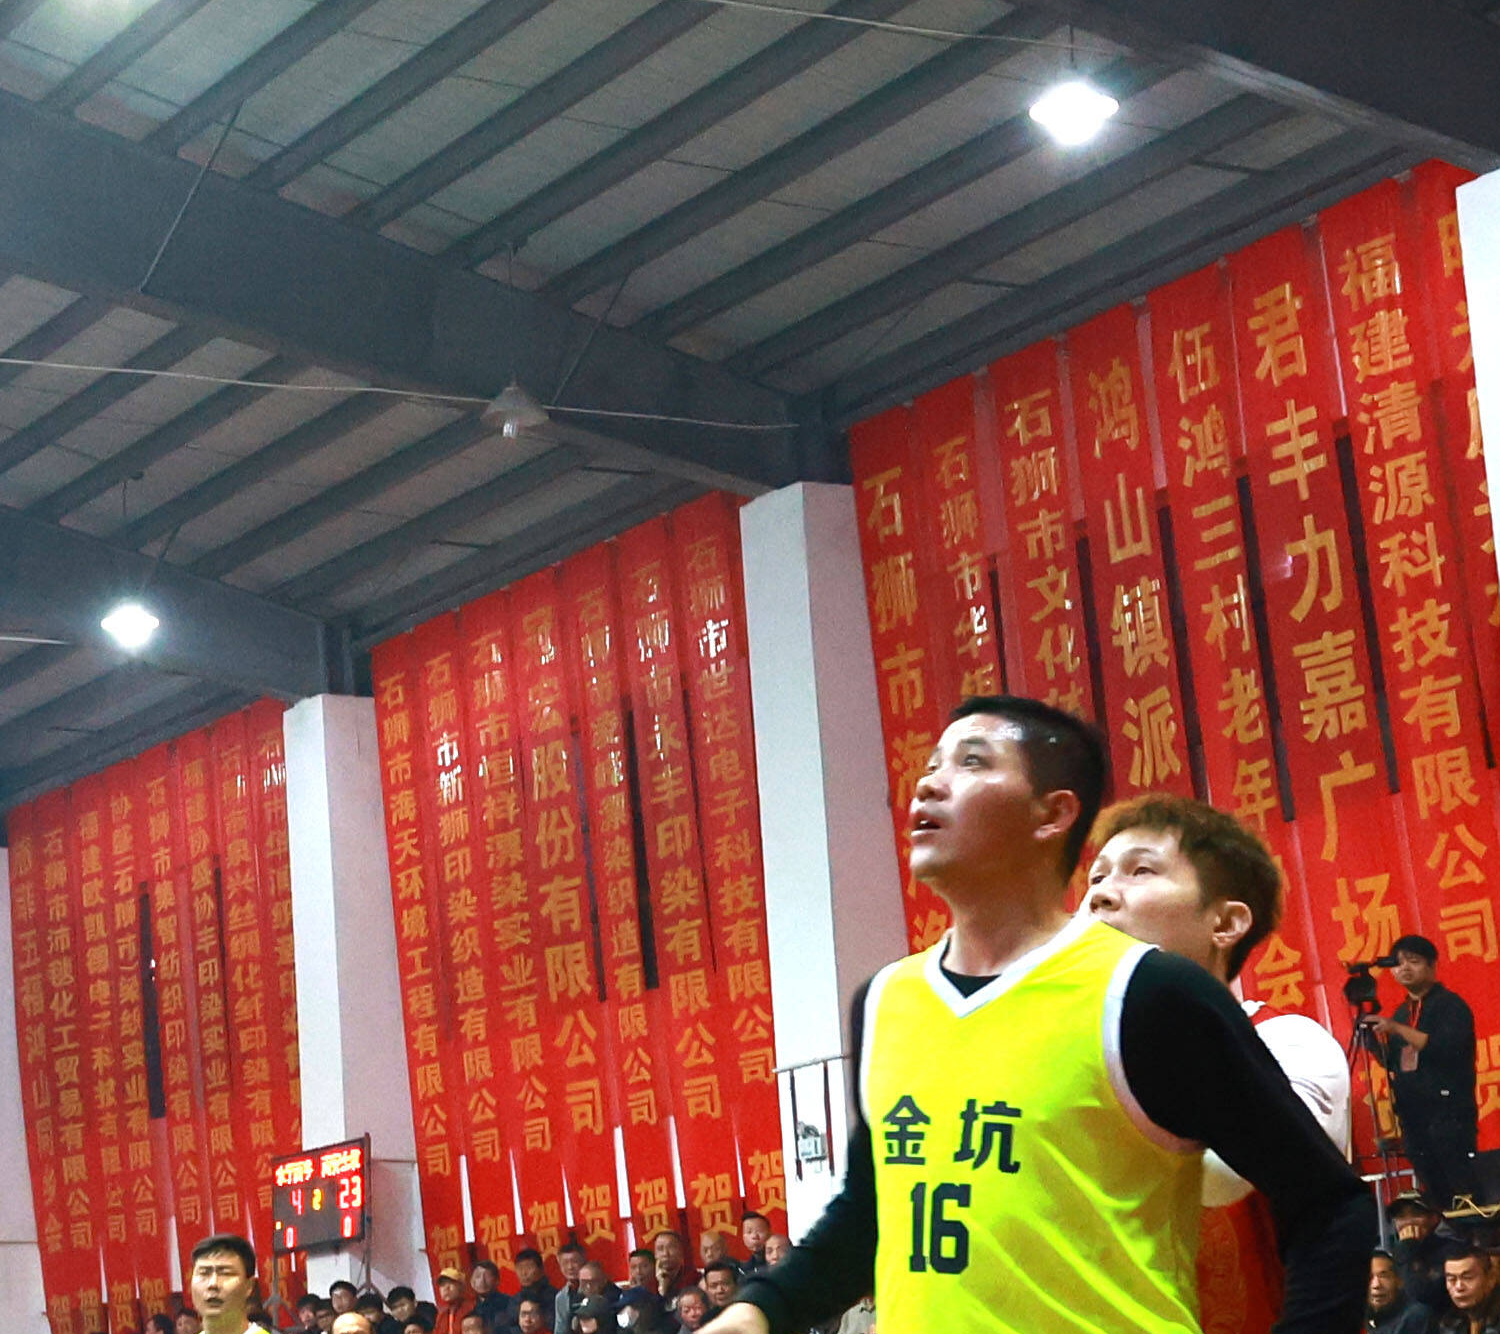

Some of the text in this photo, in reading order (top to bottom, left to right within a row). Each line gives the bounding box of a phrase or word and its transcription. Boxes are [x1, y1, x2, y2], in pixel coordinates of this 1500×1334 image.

[1246, 282, 1401, 977] 君丰力嘉广场
[1338, 233, 1498, 965] 福建清源科技有限公司
[882, 1095, 1023, 1173] 金坑
[339, 1175, 361, 1209] 23
[579, 1184, 615, 1245] 贺
[635, 1177, 669, 1242] 贺
[692, 1173, 738, 1236] 贺
[749, 1150, 787, 1215] 贺
[479, 1213, 515, 1283] 贺
[529, 1201, 561, 1259] 贺
[909, 1182, 970, 1274] 16
